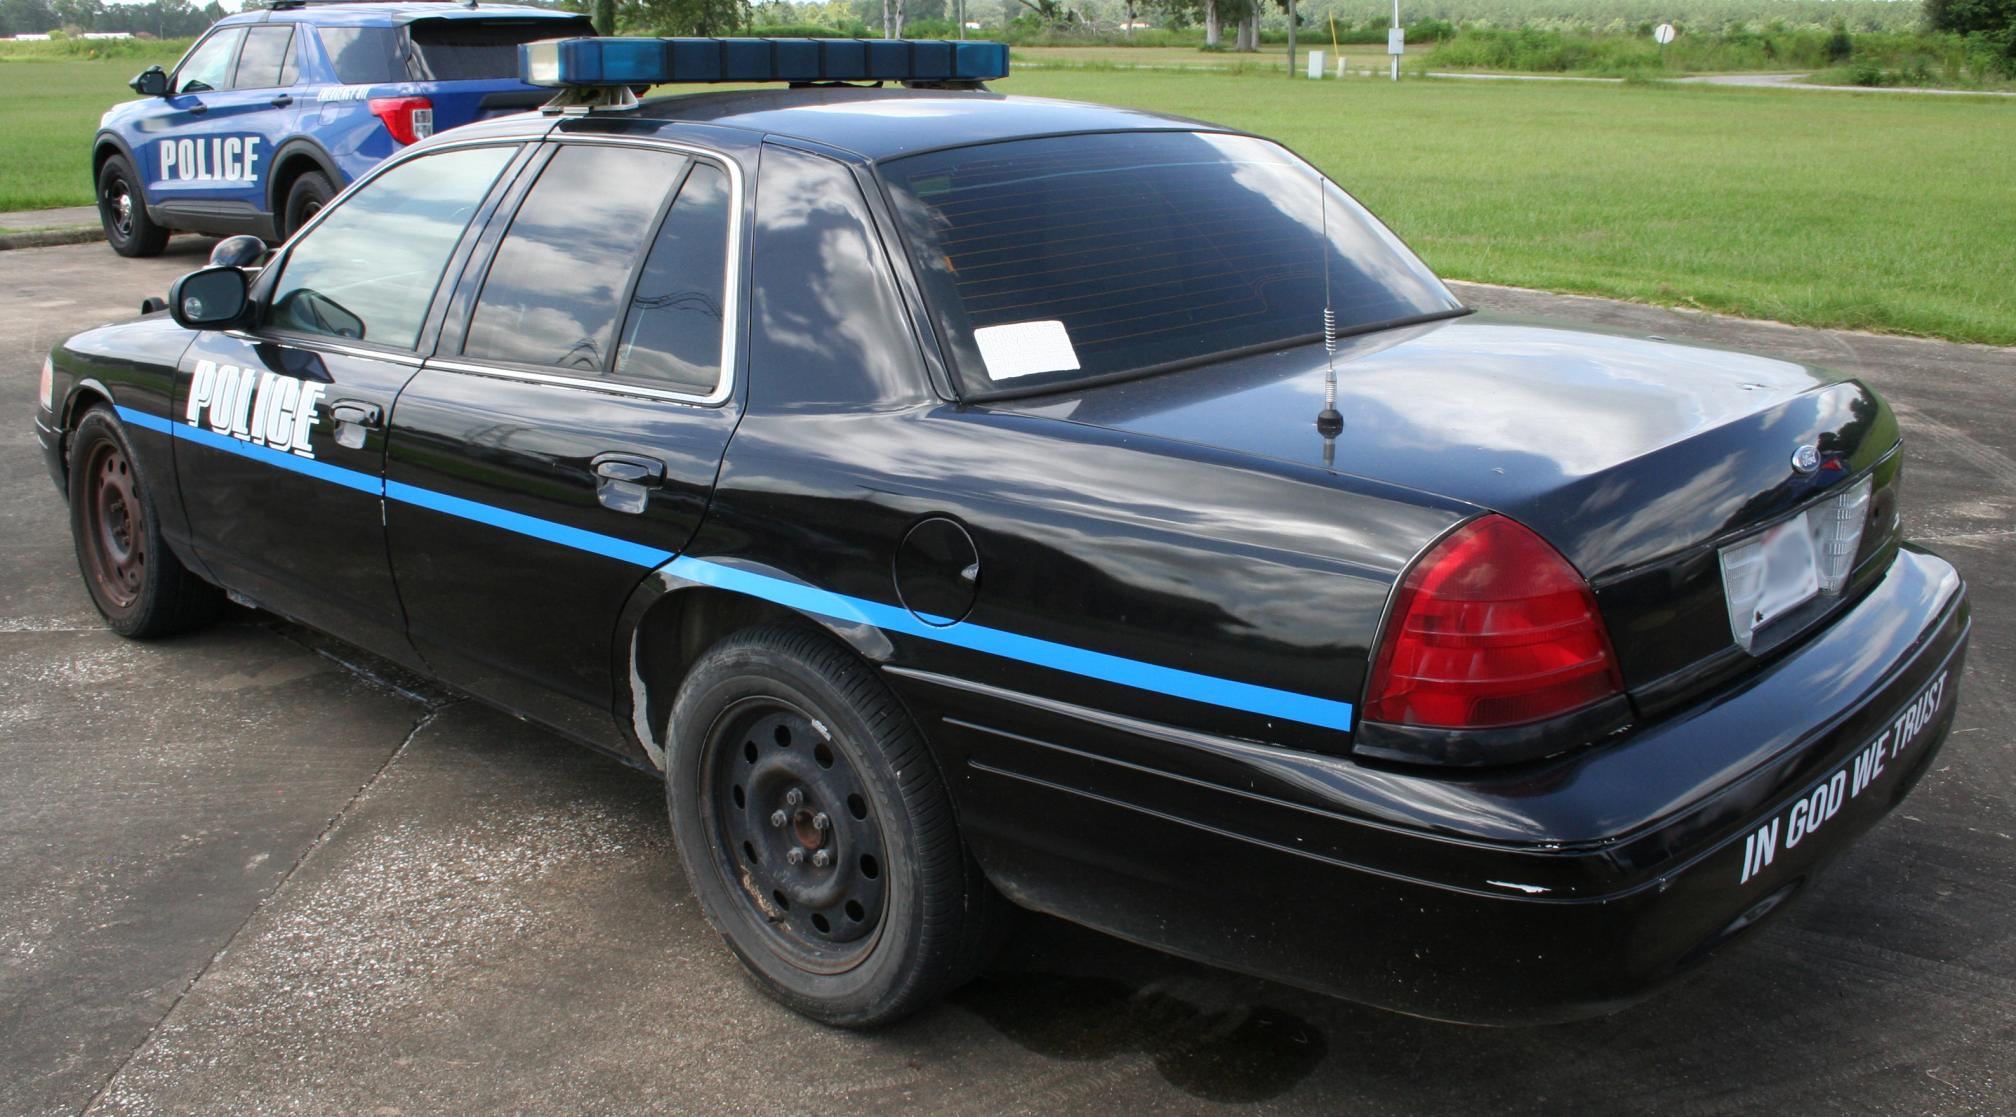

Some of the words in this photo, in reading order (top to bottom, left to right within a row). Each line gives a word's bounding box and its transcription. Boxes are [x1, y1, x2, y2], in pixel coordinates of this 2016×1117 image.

[160, 137, 260, 182] POLICE
[186, 359, 327, 459] POLICE
[1740, 816, 1779, 885] IN
[1785, 769, 1846, 849] GOD
[1851, 729, 1890, 799] WE
[1891, 669, 1947, 759] TRUST
